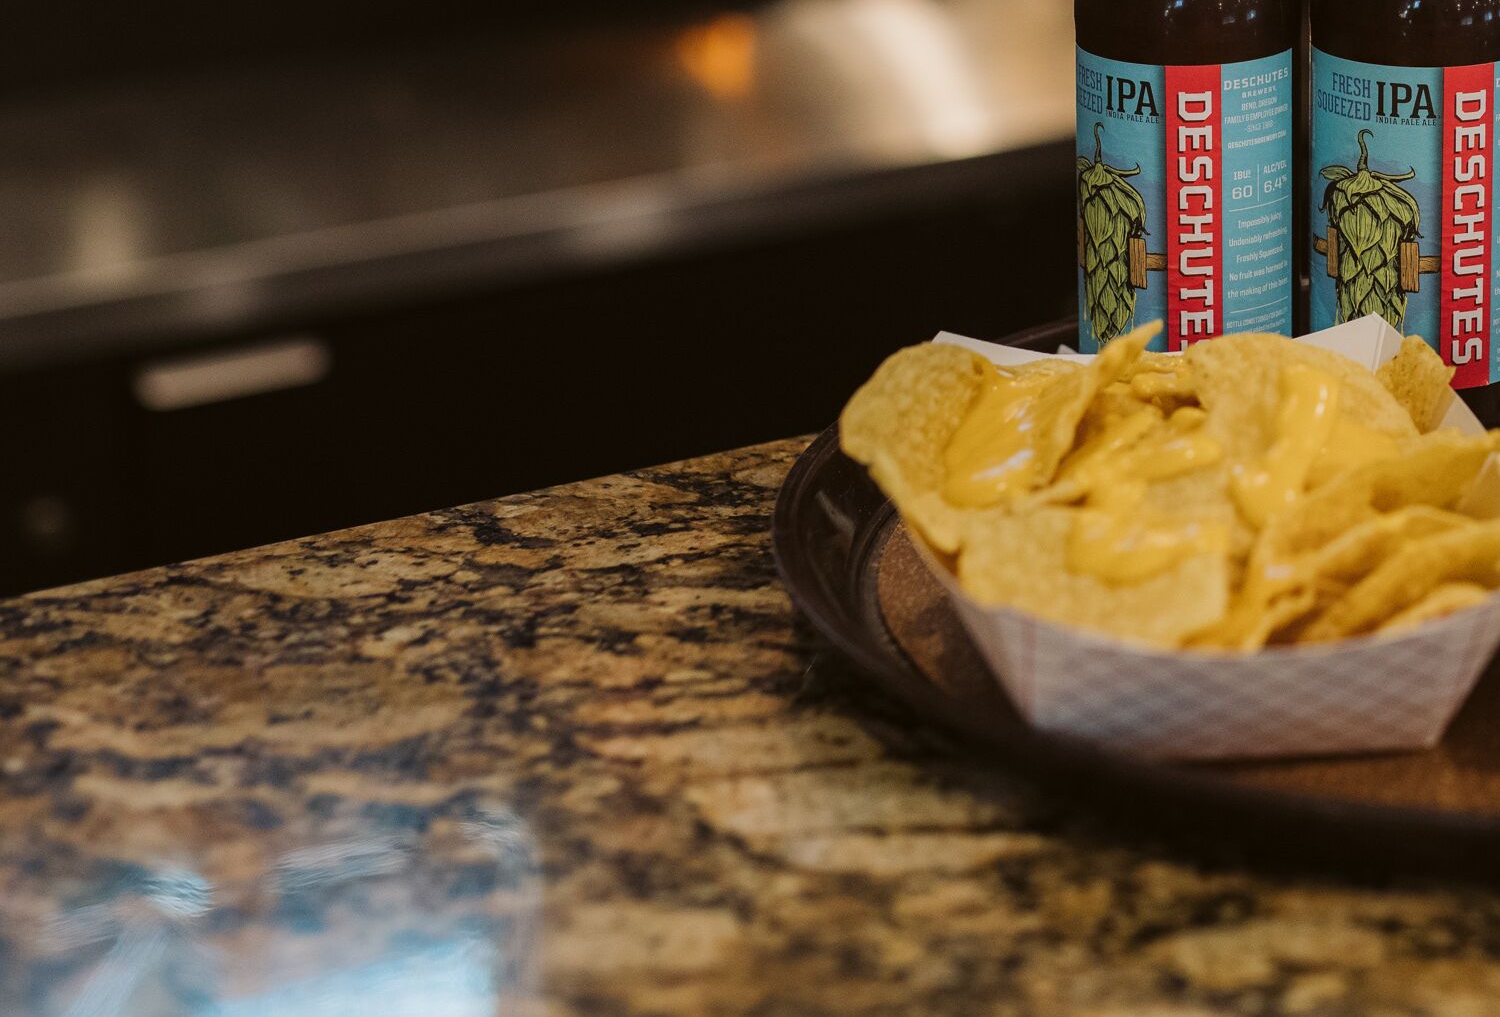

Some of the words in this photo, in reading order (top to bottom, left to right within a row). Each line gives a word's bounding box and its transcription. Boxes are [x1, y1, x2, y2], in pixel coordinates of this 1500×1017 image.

[1079, 63, 1102, 92] FRESH
[1224, 67, 1289, 91] DESCHUTES
[1332, 72, 1371, 98] FRESH
[1106, 74, 1160, 116] IPA
[1316, 89, 1371, 121] SQUEEZED
[1376, 81, 1437, 118] IPA
[1106, 109, 1124, 121] INDIA
[1126, 114, 1144, 123] PALE
[1146, 116, 1160, 124] ALE
[1376, 116, 1398, 125] INDIA
[1401, 118, 1420, 126] PALE
[1232, 185, 1253, 200] 60
[1178, 92, 1214, 349] DESCHUTE
[1452, 89, 1487, 366] DESCHUTES
[1236, 252, 1259, 264] Freshly
[1229, 271, 1239, 282] No
[1239, 270, 1253, 280] fruit
[1227, 289, 1239, 299] the
[1239, 286, 1262, 297] making
